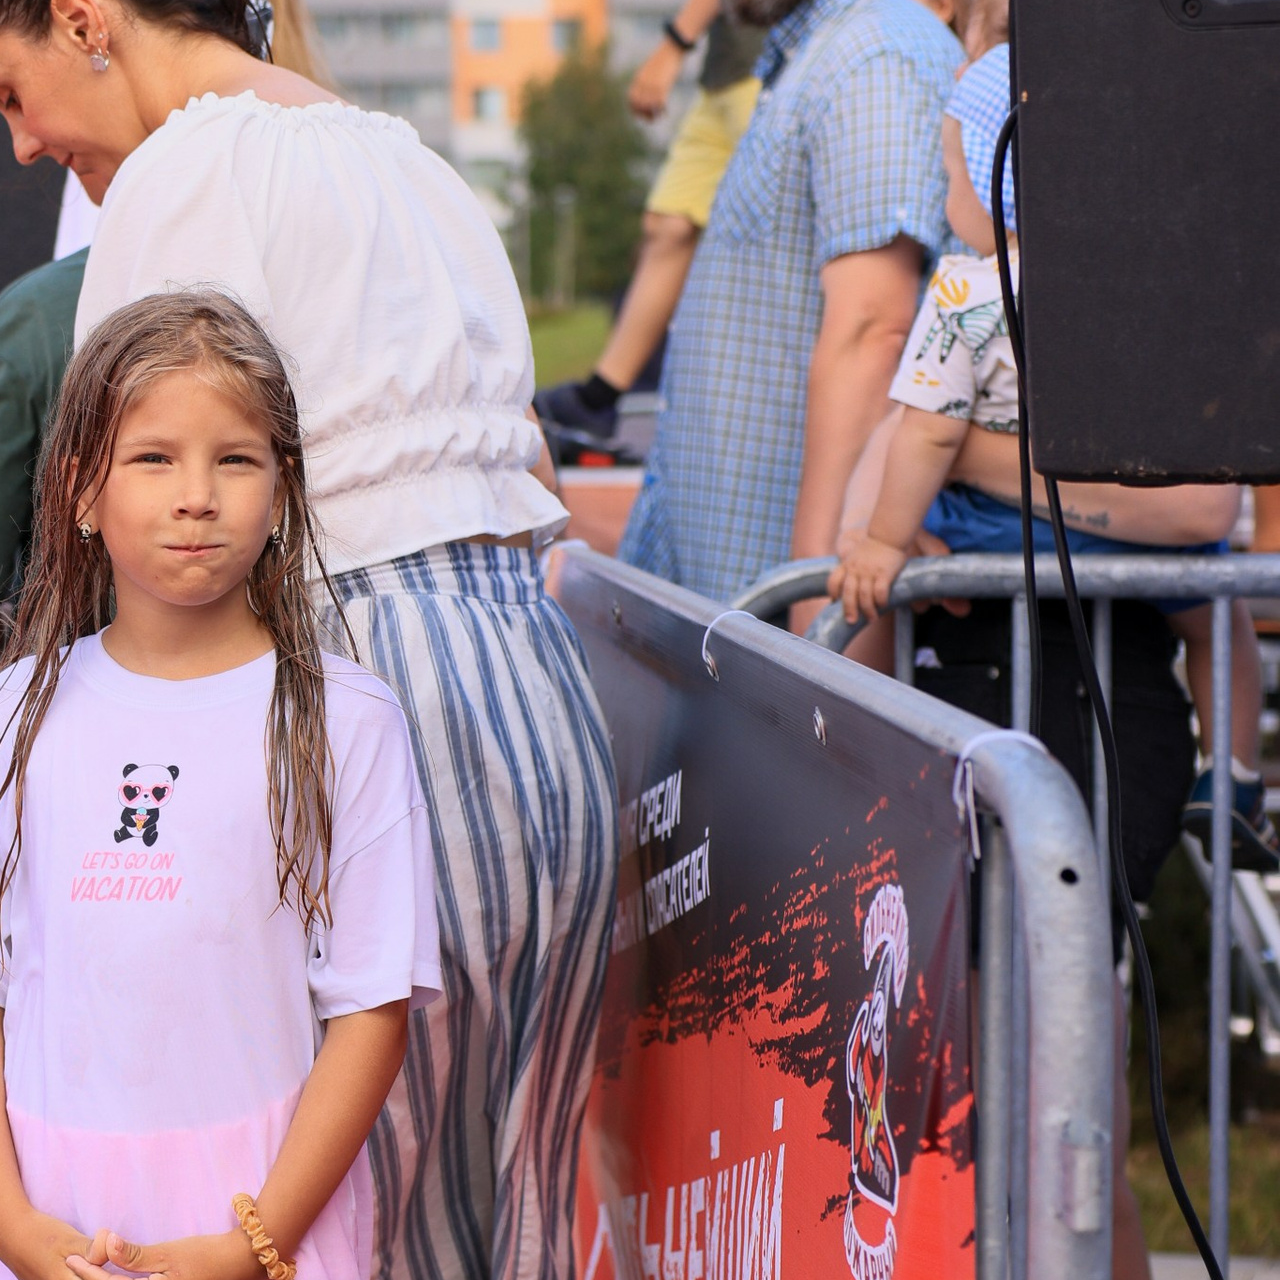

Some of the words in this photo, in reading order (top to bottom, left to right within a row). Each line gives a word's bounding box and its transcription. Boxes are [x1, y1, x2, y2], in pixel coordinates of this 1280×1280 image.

[639, 769, 682, 847] СРЕДИ
[82, 851, 123, 870] LET'S
[124, 853, 149, 870] GO
[150, 852, 175, 870] ON
[71, 875, 183, 902] VACATION
